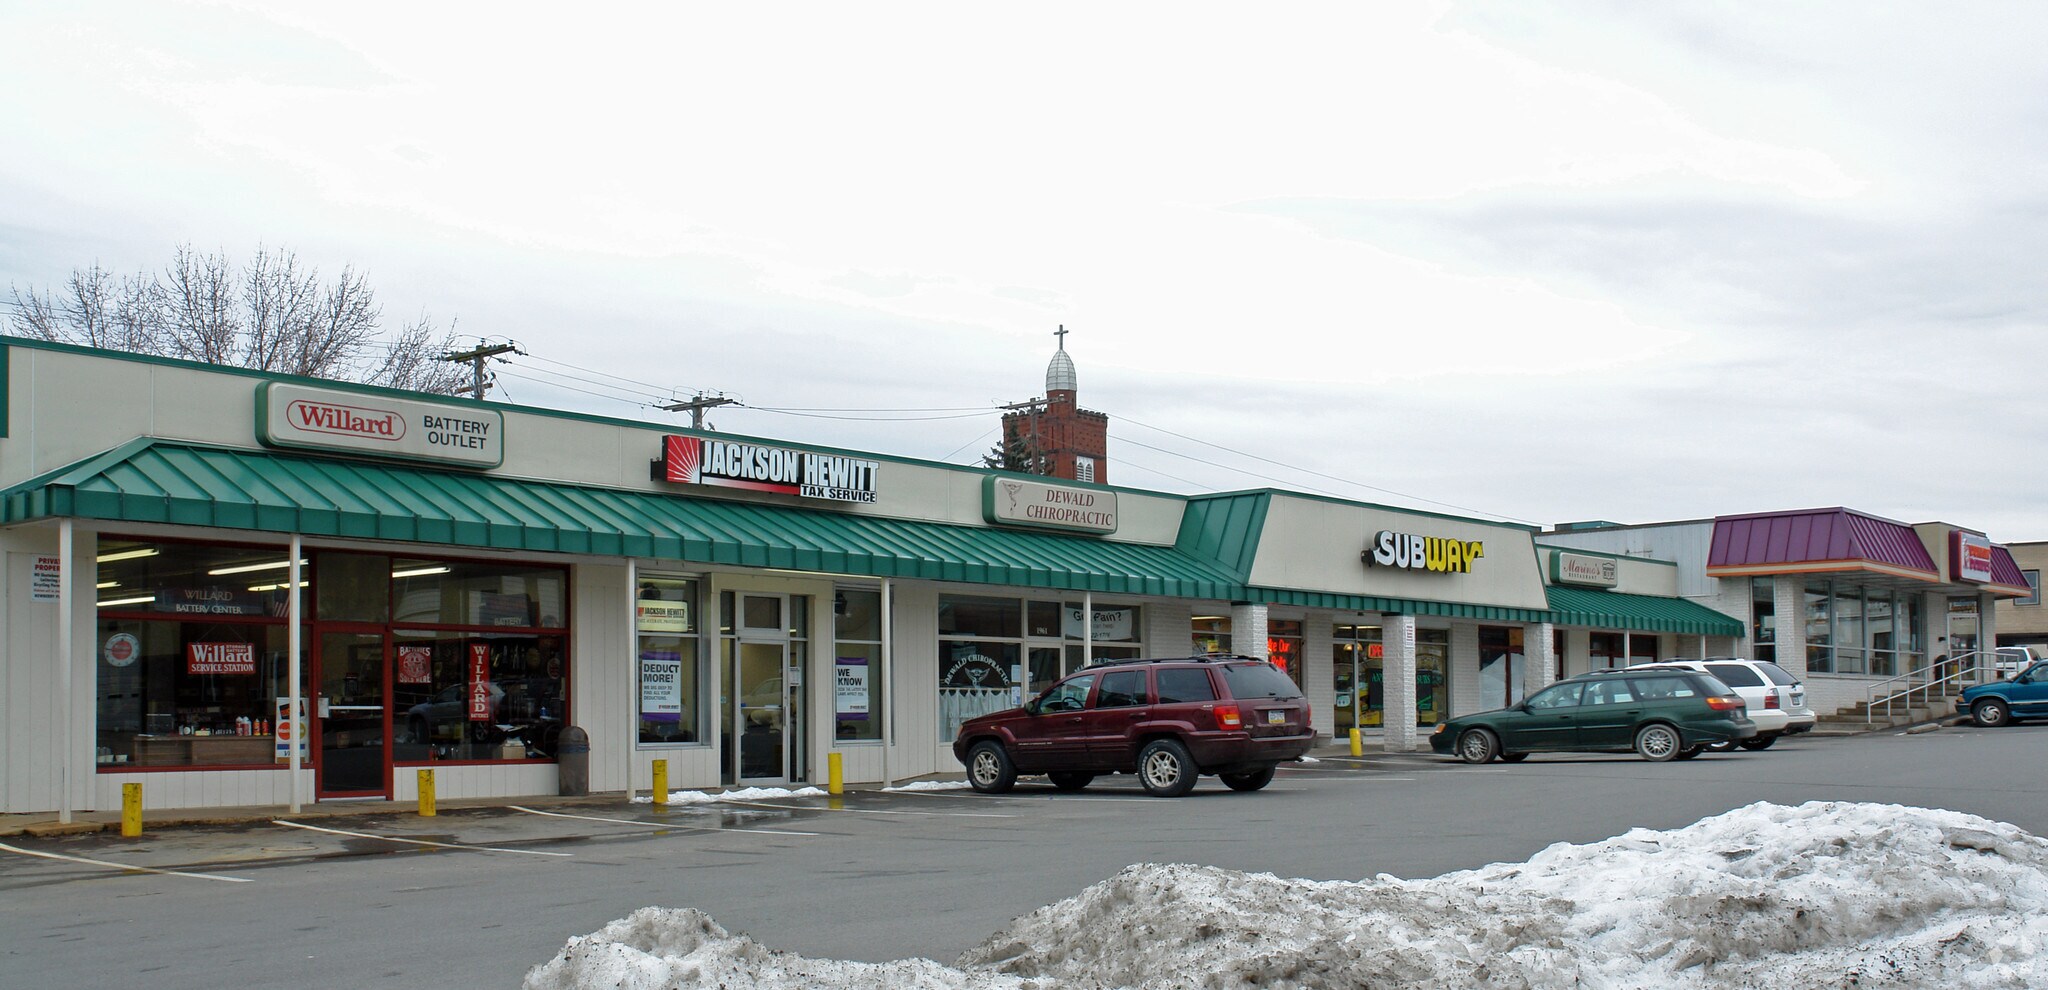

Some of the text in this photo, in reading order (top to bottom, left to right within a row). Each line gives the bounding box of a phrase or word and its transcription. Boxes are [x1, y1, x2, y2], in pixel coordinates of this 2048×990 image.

[298, 404, 394, 436] Willard
[423, 415, 490, 435] BATTERY
[427, 431, 487, 450] OUTLET
[701, 440, 879, 492] JACKSON HEWITT
[802, 484, 876, 503] TAX SERVICE
[1046, 489, 1095, 507] DEWALD
[1026, 504, 1113, 526] CHIROPRACTIC
[1373, 530, 1484, 574] SUBWAY
[1563, 559, 1601, 576] Marino's
[184, 589, 234, 602] WILLARD
[175, 603, 243, 614] BATTERY CENTER
[1093, 611, 1122, 623] Pain?
[493, 616, 523, 628] BATTERY
[191, 644, 254, 663] Willard
[1370, 644, 1383, 658] OPE
[191, 663, 254, 672] SERVICE STATION
[643, 663, 680, 674] DEDUCT
[837, 668, 850, 677] WE
[944, 654, 1010, 686] DEWALD CHIROPRACTIC
[416, 675, 432, 683] HERE
[472, 645, 487, 713] WILLARD
[643, 673, 674, 683] MORE!
[837, 677, 863, 686] KNOW
